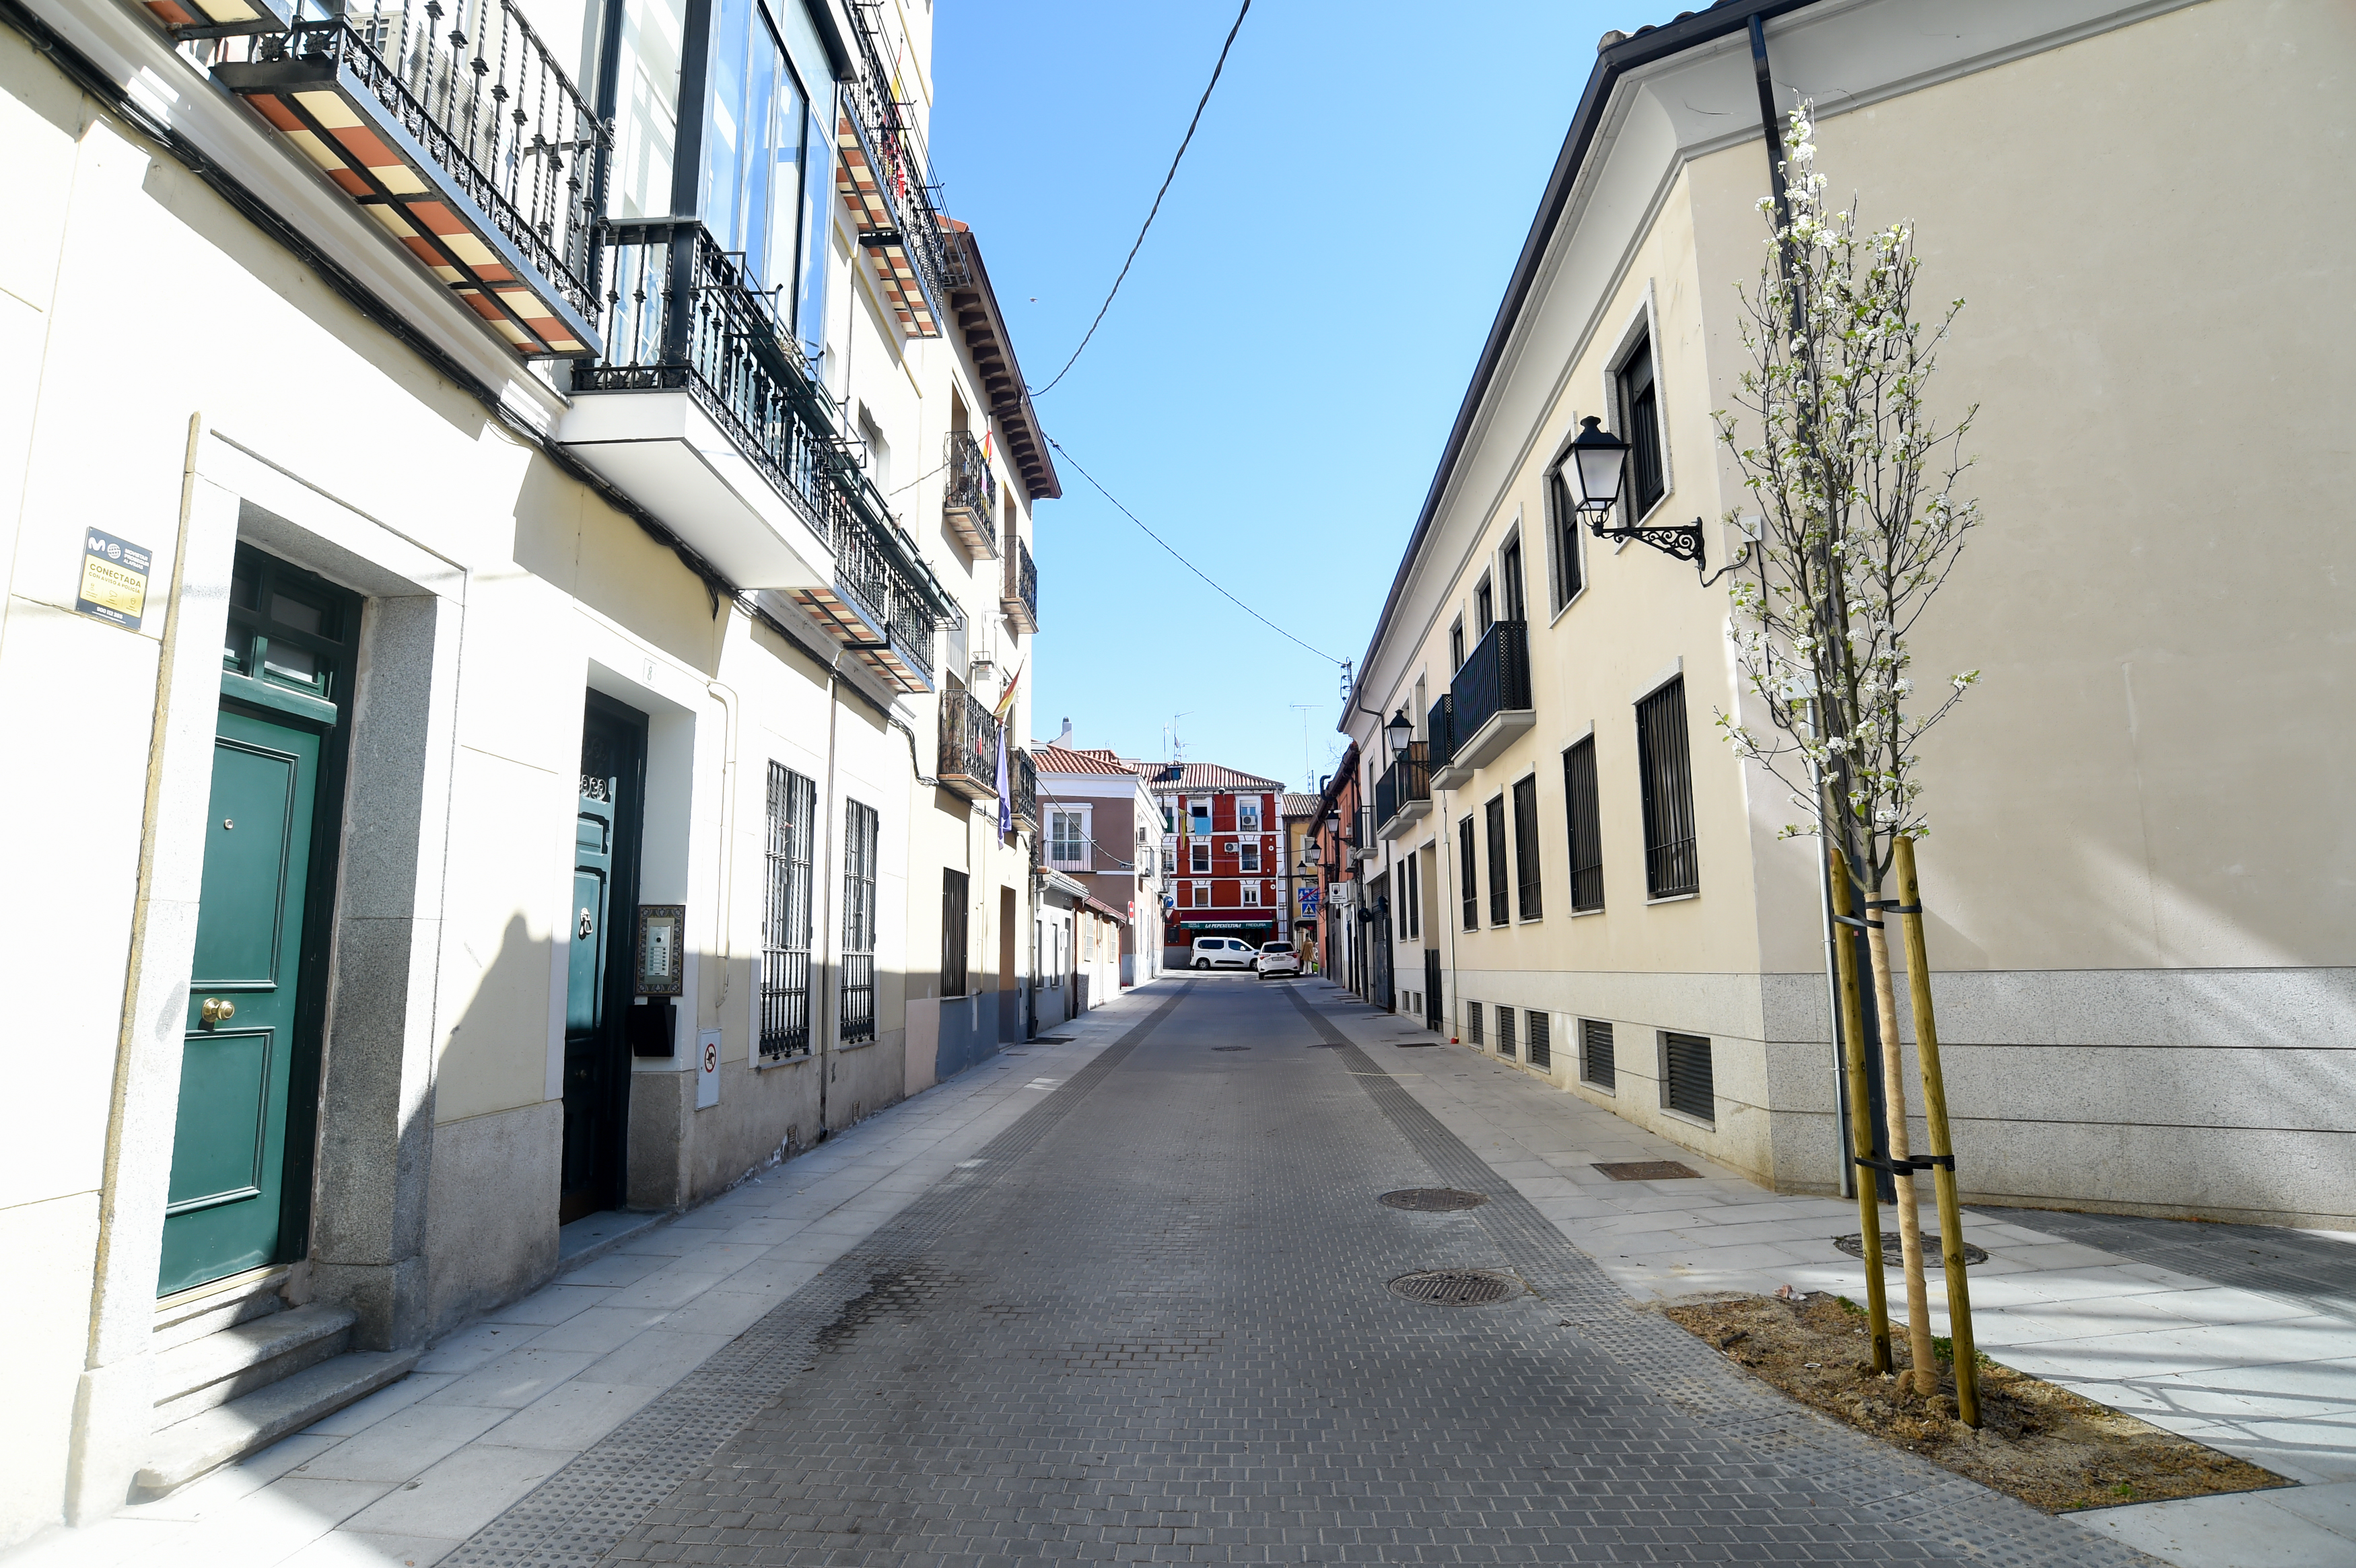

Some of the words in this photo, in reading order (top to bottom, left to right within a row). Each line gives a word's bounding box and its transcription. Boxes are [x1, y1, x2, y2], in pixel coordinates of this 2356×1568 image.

[124, 553, 149, 567] PROSEGUR
[125, 548, 148, 561] MOVISTAR
[123, 559, 143, 570] ALARMAS
[90, 563, 141, 587] CONECTADA
[89, 571, 100, 579] CON
[101, 577, 116, 585] AVISO
[122, 583, 140, 594] POLICÍA
